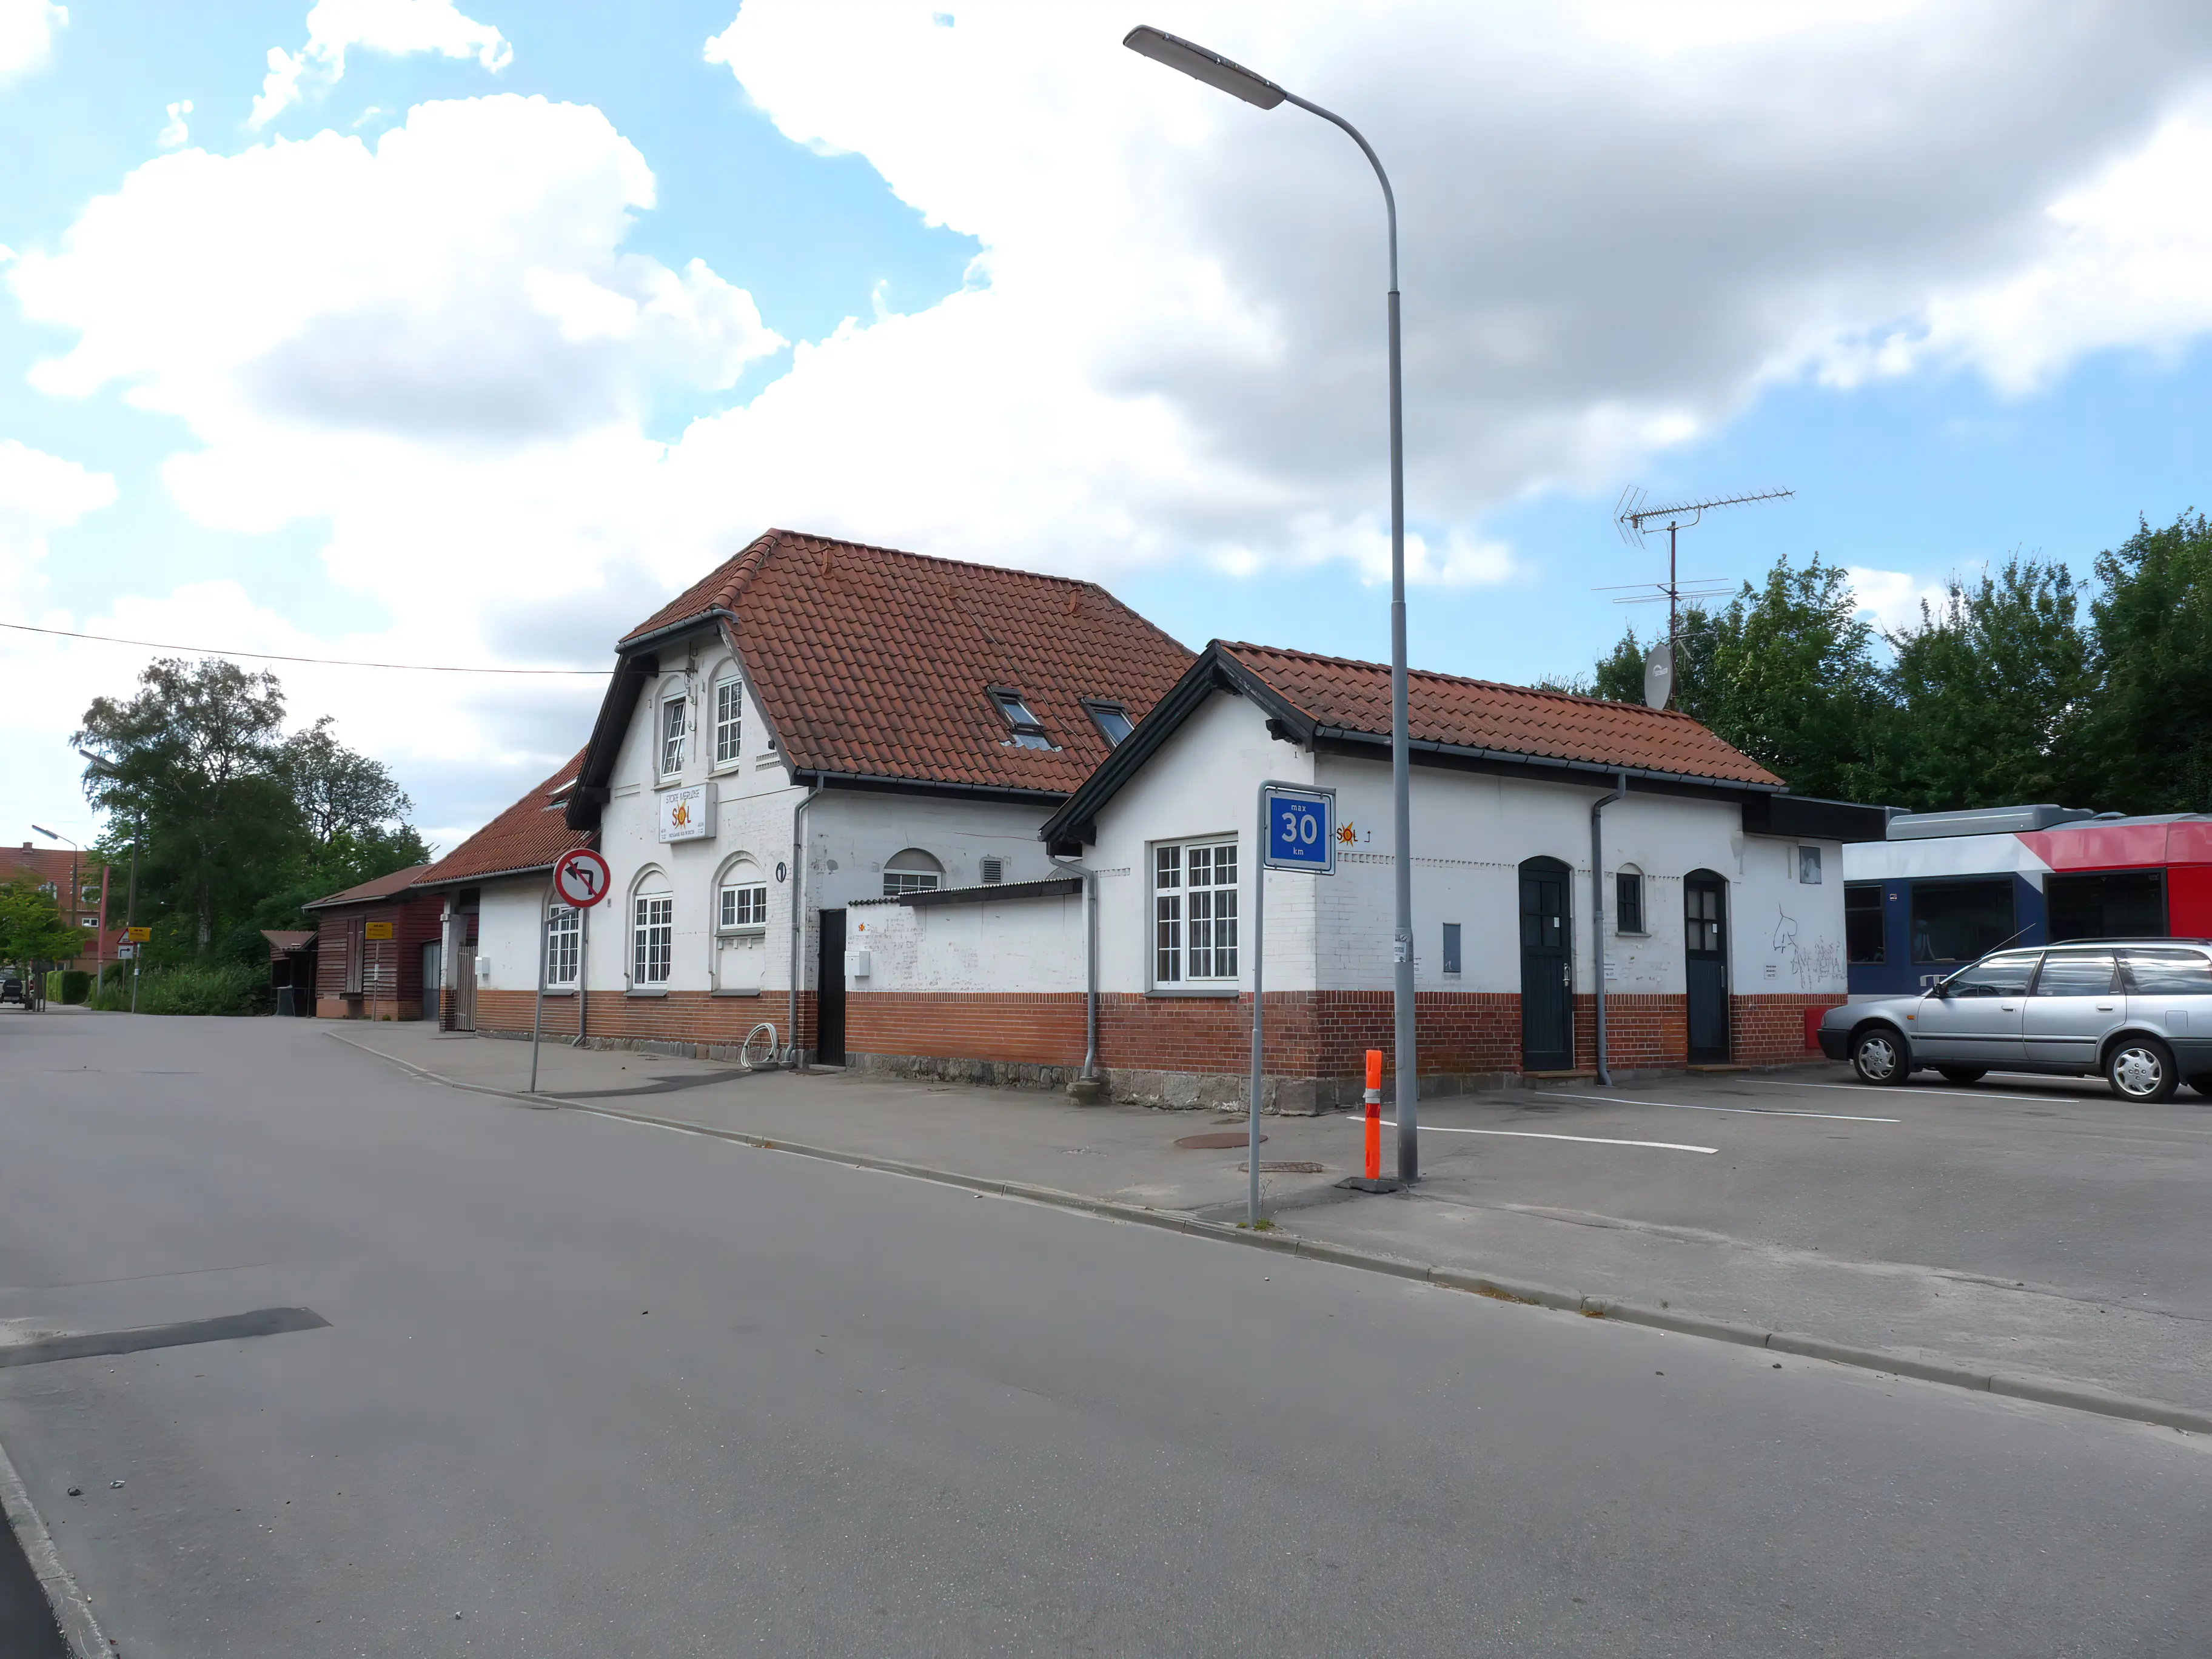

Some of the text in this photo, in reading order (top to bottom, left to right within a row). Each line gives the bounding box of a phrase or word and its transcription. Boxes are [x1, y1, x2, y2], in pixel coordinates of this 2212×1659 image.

[672, 805, 691, 826] SOL
[1281, 812, 1318, 845] 30
[1336, 828, 1358, 842] SOL
[1293, 846, 1304, 856] km
